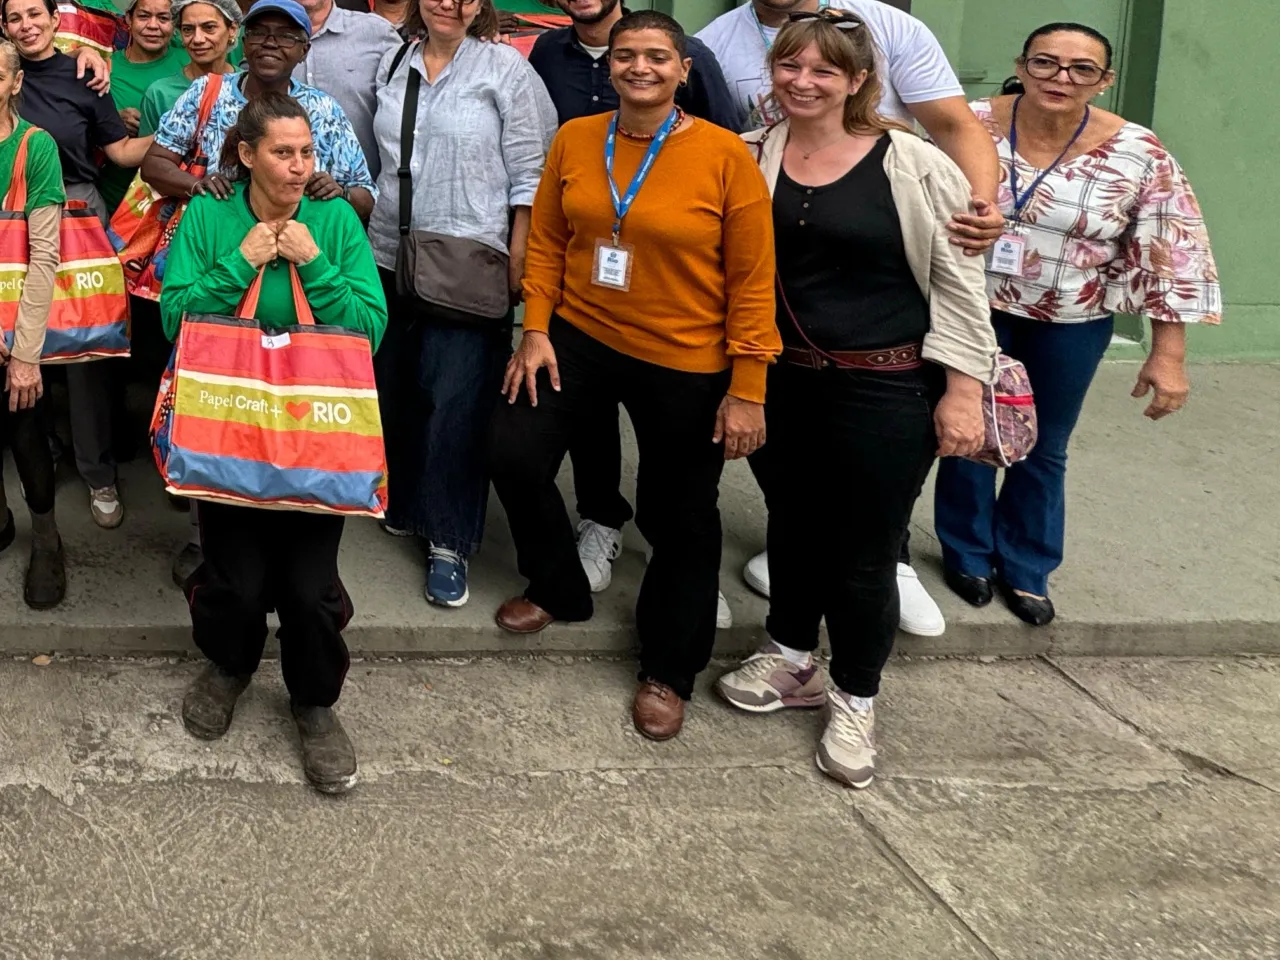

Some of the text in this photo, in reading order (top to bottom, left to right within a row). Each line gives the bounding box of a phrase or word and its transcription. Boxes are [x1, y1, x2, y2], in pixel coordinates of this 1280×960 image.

[75, 270, 104, 290] RIO
[199, 389, 234, 411] Papel
[235, 395, 269, 414] Craft
[313, 400, 352, 425] RIO
